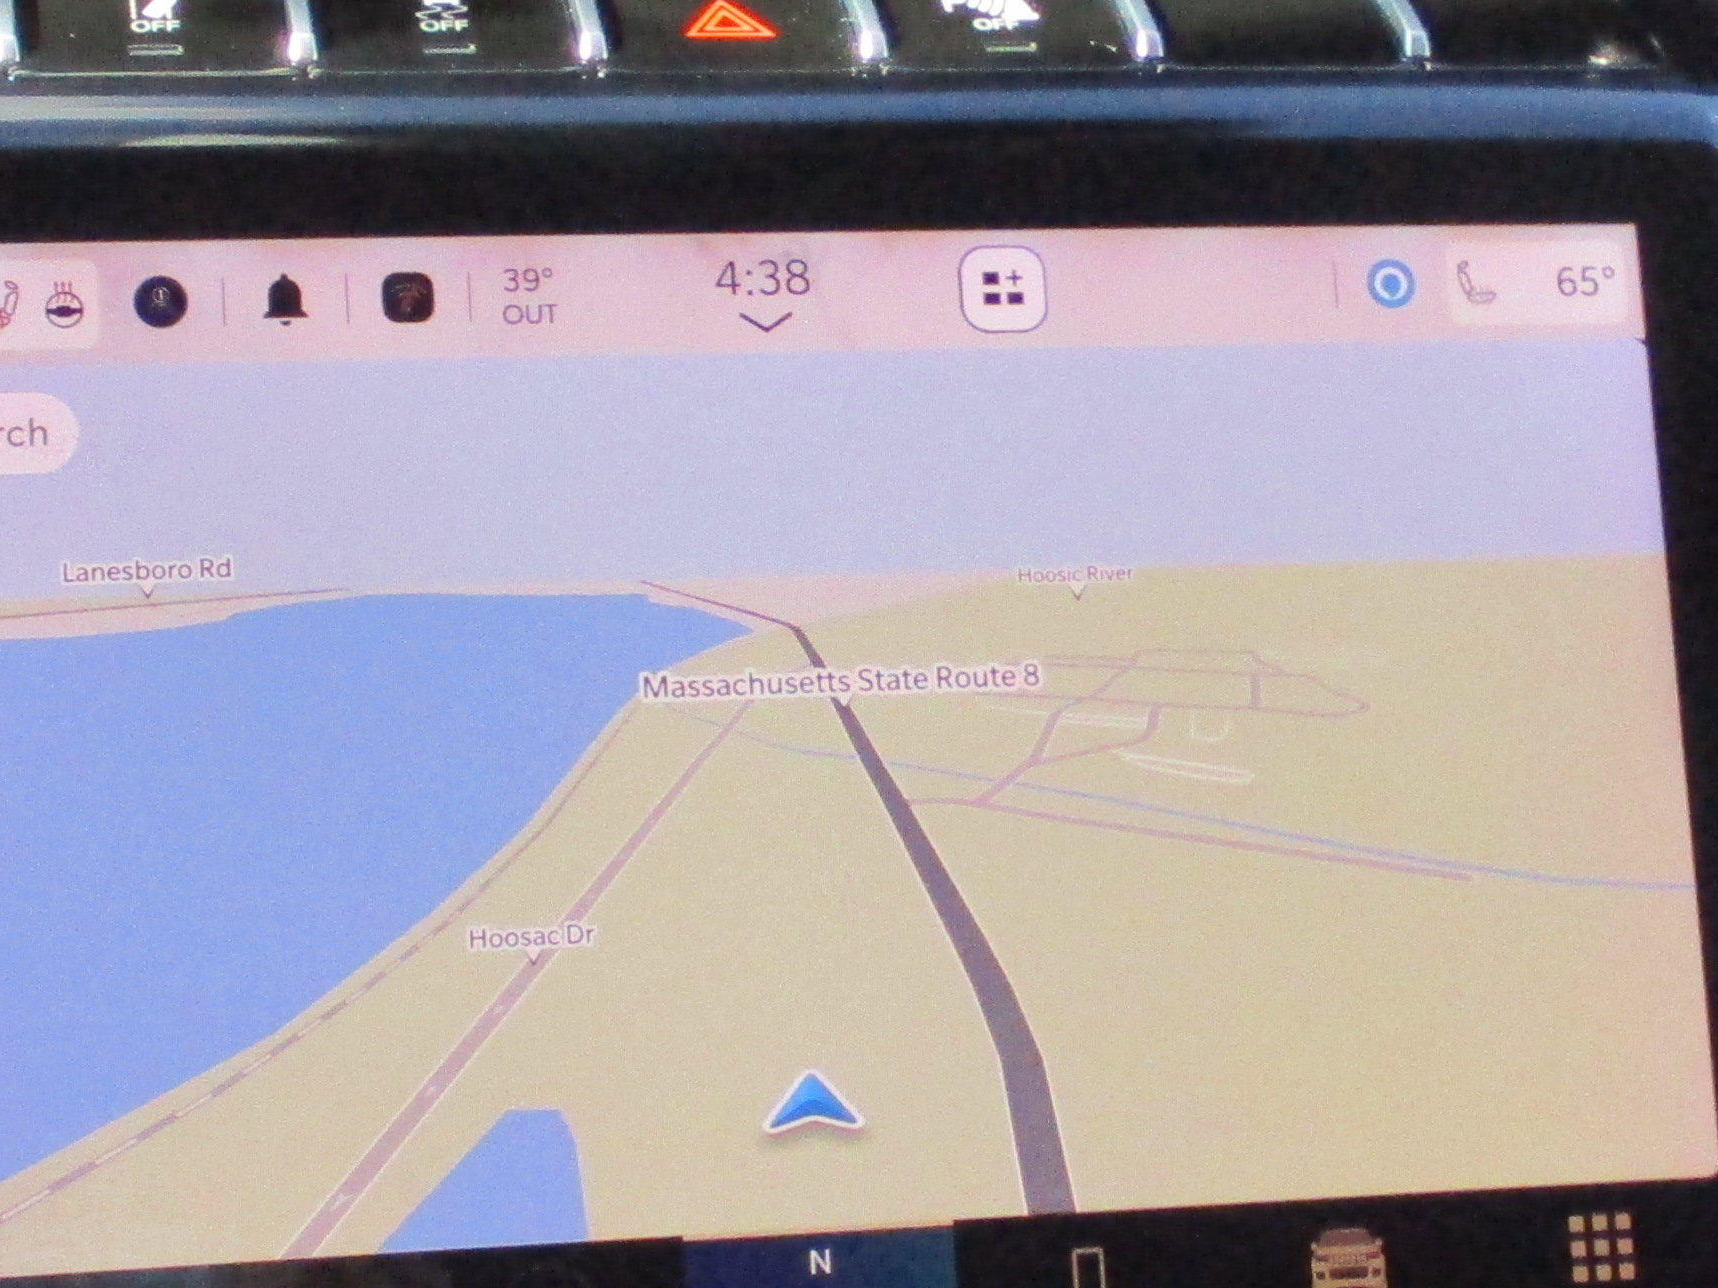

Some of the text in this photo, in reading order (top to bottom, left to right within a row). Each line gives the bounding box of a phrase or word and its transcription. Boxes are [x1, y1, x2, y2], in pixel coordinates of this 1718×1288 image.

[129, 19, 183, 34] OFF
[417, 18, 469, 33] OFF
[972, 17, 1020, 31] OFF
[502, 267, 554, 293] 39°
[715, 258, 811, 296] 4:38
[1556, 265, 1616, 297] 65°
[502, 303, 558, 325] OUT
[62, 557, 232, 583] Lanesboro Rd
[1017, 565, 1134, 585] Hoosic River
[643, 663, 1041, 699] Massachusetts State Route 8
[468, 923, 596, 951] Hoosac Dr
[809, 1250, 832, 1276] N
